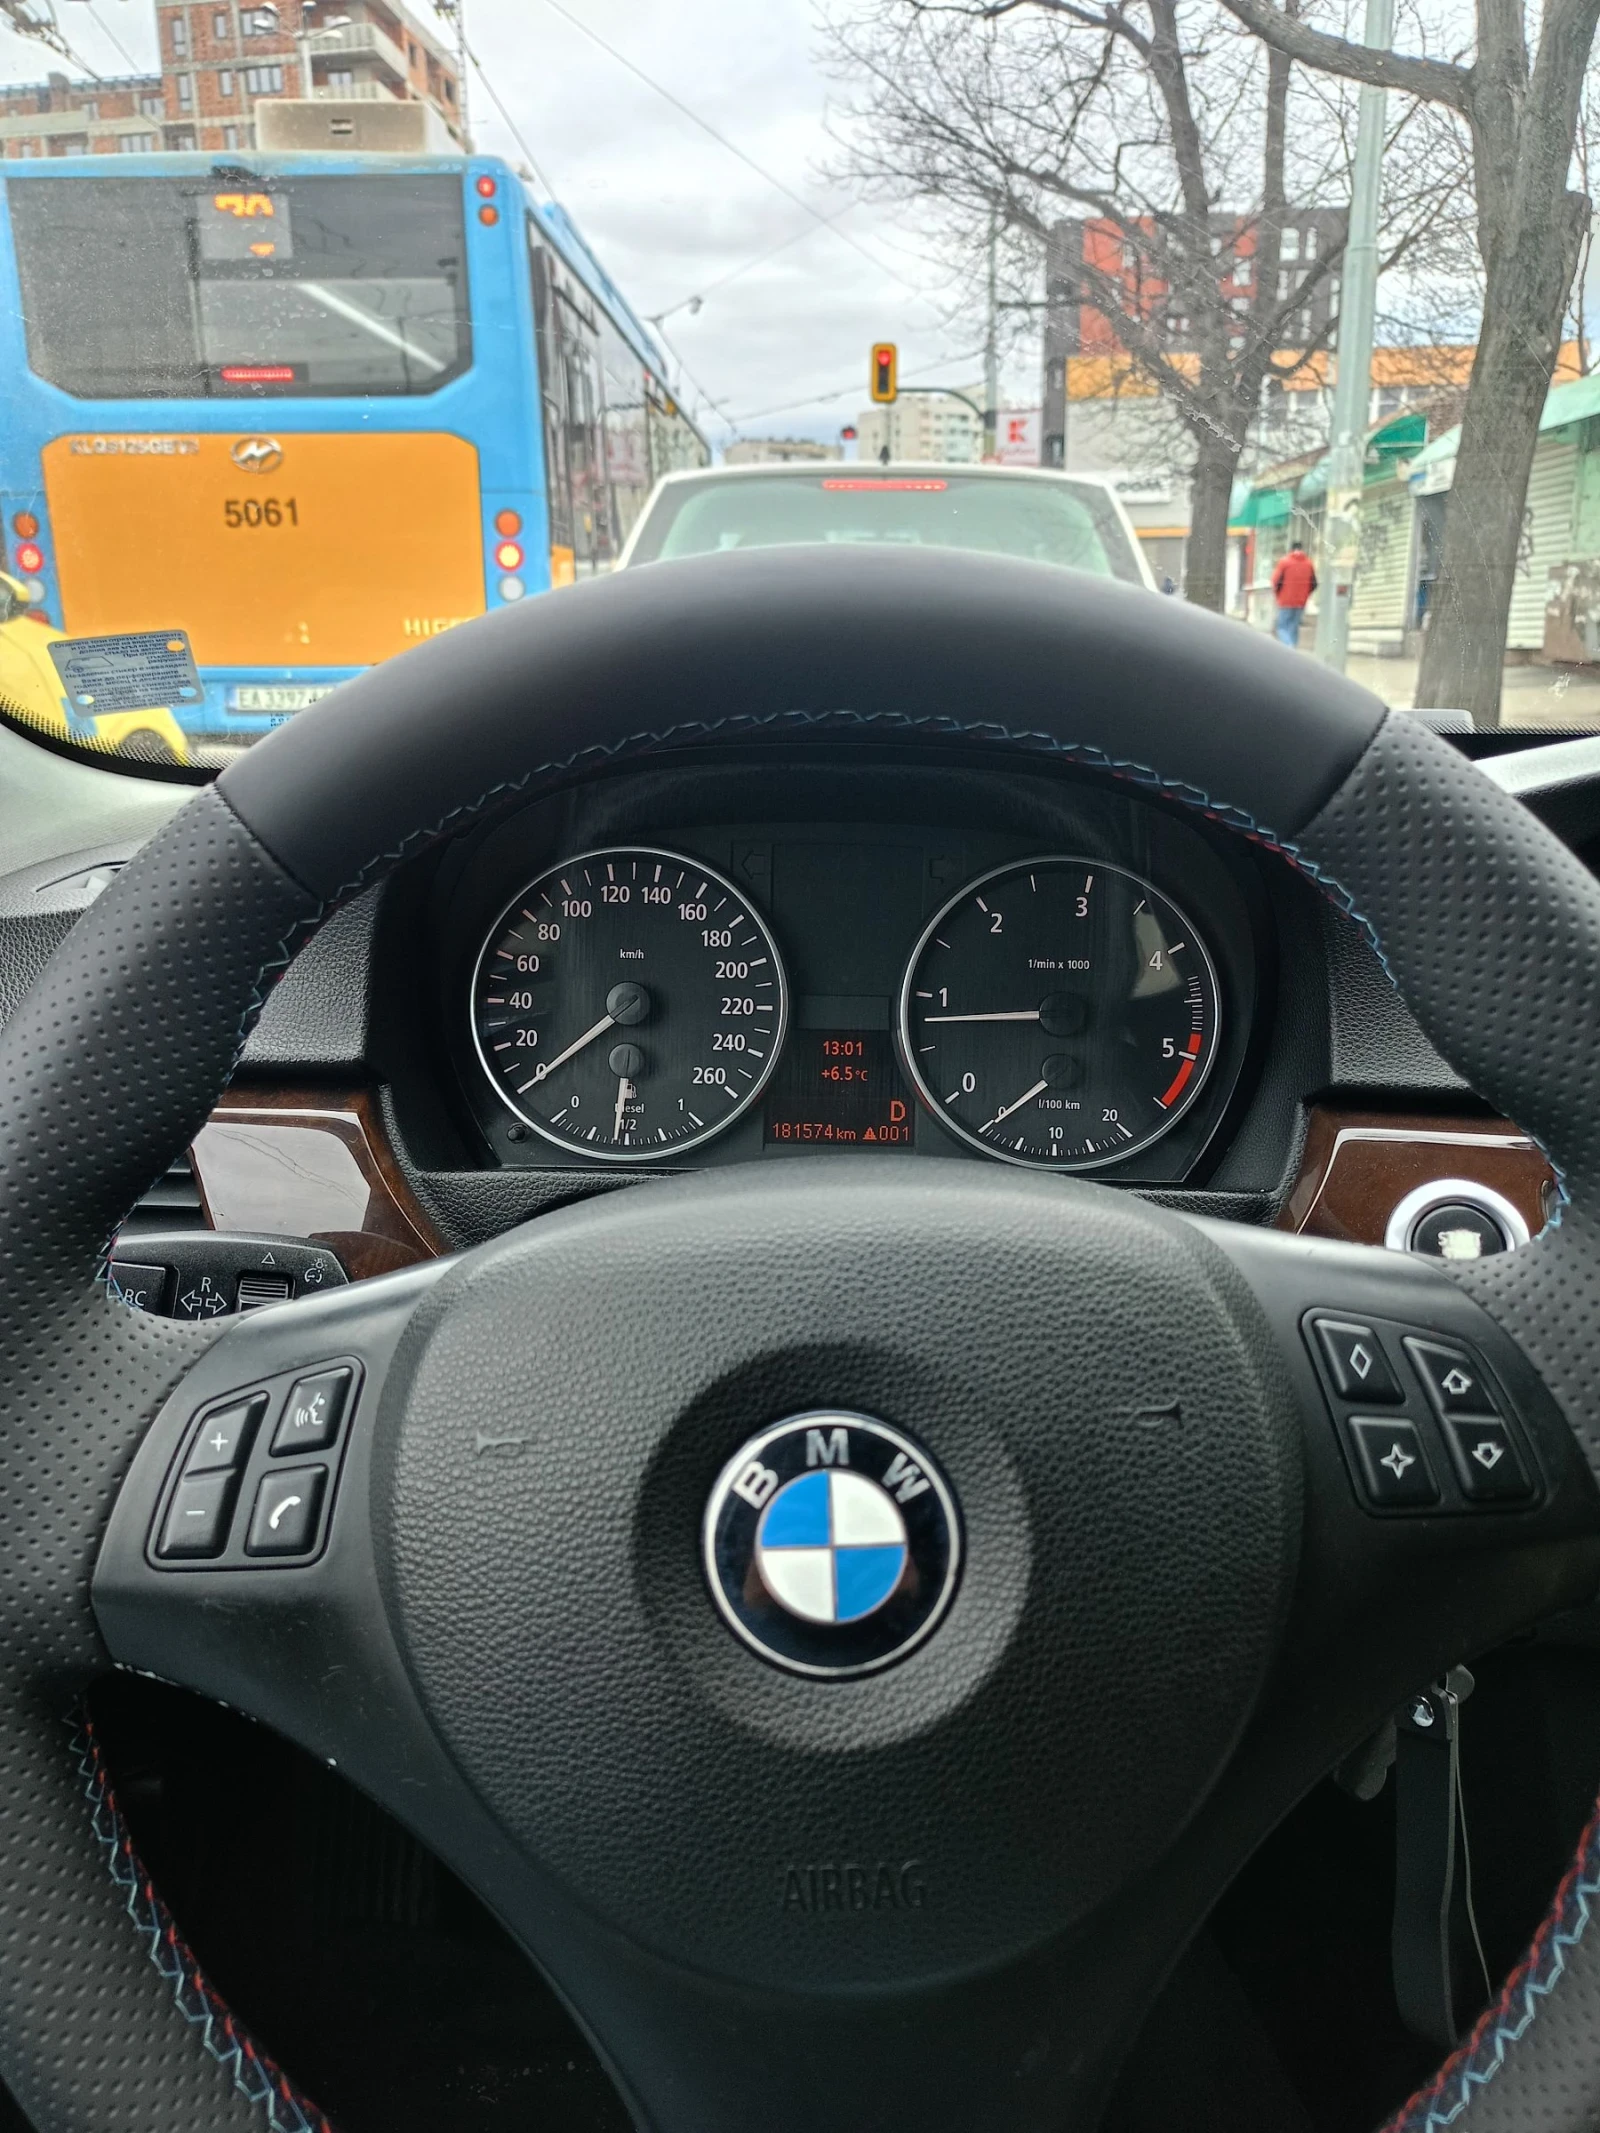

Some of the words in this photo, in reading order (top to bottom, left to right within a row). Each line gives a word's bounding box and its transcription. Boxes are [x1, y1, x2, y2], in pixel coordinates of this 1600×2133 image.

[225, 498, 299, 528] 5061
[600, 886, 630, 903] 120
[641, 887, 671, 904] 140
[561, 900, 592, 918] 100
[677, 903, 707, 921] 160
[1075, 896, 1088, 917] 3
[990, 912, 1003, 933] 2
[537, 923, 561, 941] 80
[701, 929, 732, 947] 180
[517, 954, 540, 972] 60
[619, 948, 645, 960] km/h
[1149, 950, 1163, 971] 4
[715, 961, 748, 979] 200
[1028, 959, 1055, 970] 1/min
[1067, 959, 1090, 970] 1000
[509, 991, 533, 1010] 40
[721, 997, 754, 1016] 220
[939, 987, 948, 1008] 1
[515, 1029, 538, 1047] 20
[712, 1033, 746, 1052] 240
[823, 1041, 863, 1056] 13:01
[1162, 1037, 1175, 1058] 5
[535, 1063, 547, 1080] 0
[692, 1066, 727, 1085] 260
[962, 1072, 976, 1093] 0
[571, 1095, 580, 1108] 0
[615, 1103, 645, 1113] esel
[677, 1098, 684, 1111] 1
[1065, 1099, 1080, 1110] km
[890, 1101, 906, 1122] D
[1102, 1108, 1118, 1122] 20
[620, 1118, 637, 1130] 1/2
[772, 1123, 833, 1139] 181574
[836, 1128, 856, 1140] km
[879, 1126, 909, 1141] 001
[1048, 1126, 1064, 1139] 10
[200, 1277, 212, 1293] R
[123, 1289, 146, 1307] BC
[731, 1427, 931, 1510] BMW
[783, 1858, 928, 1912] AIRBAG
